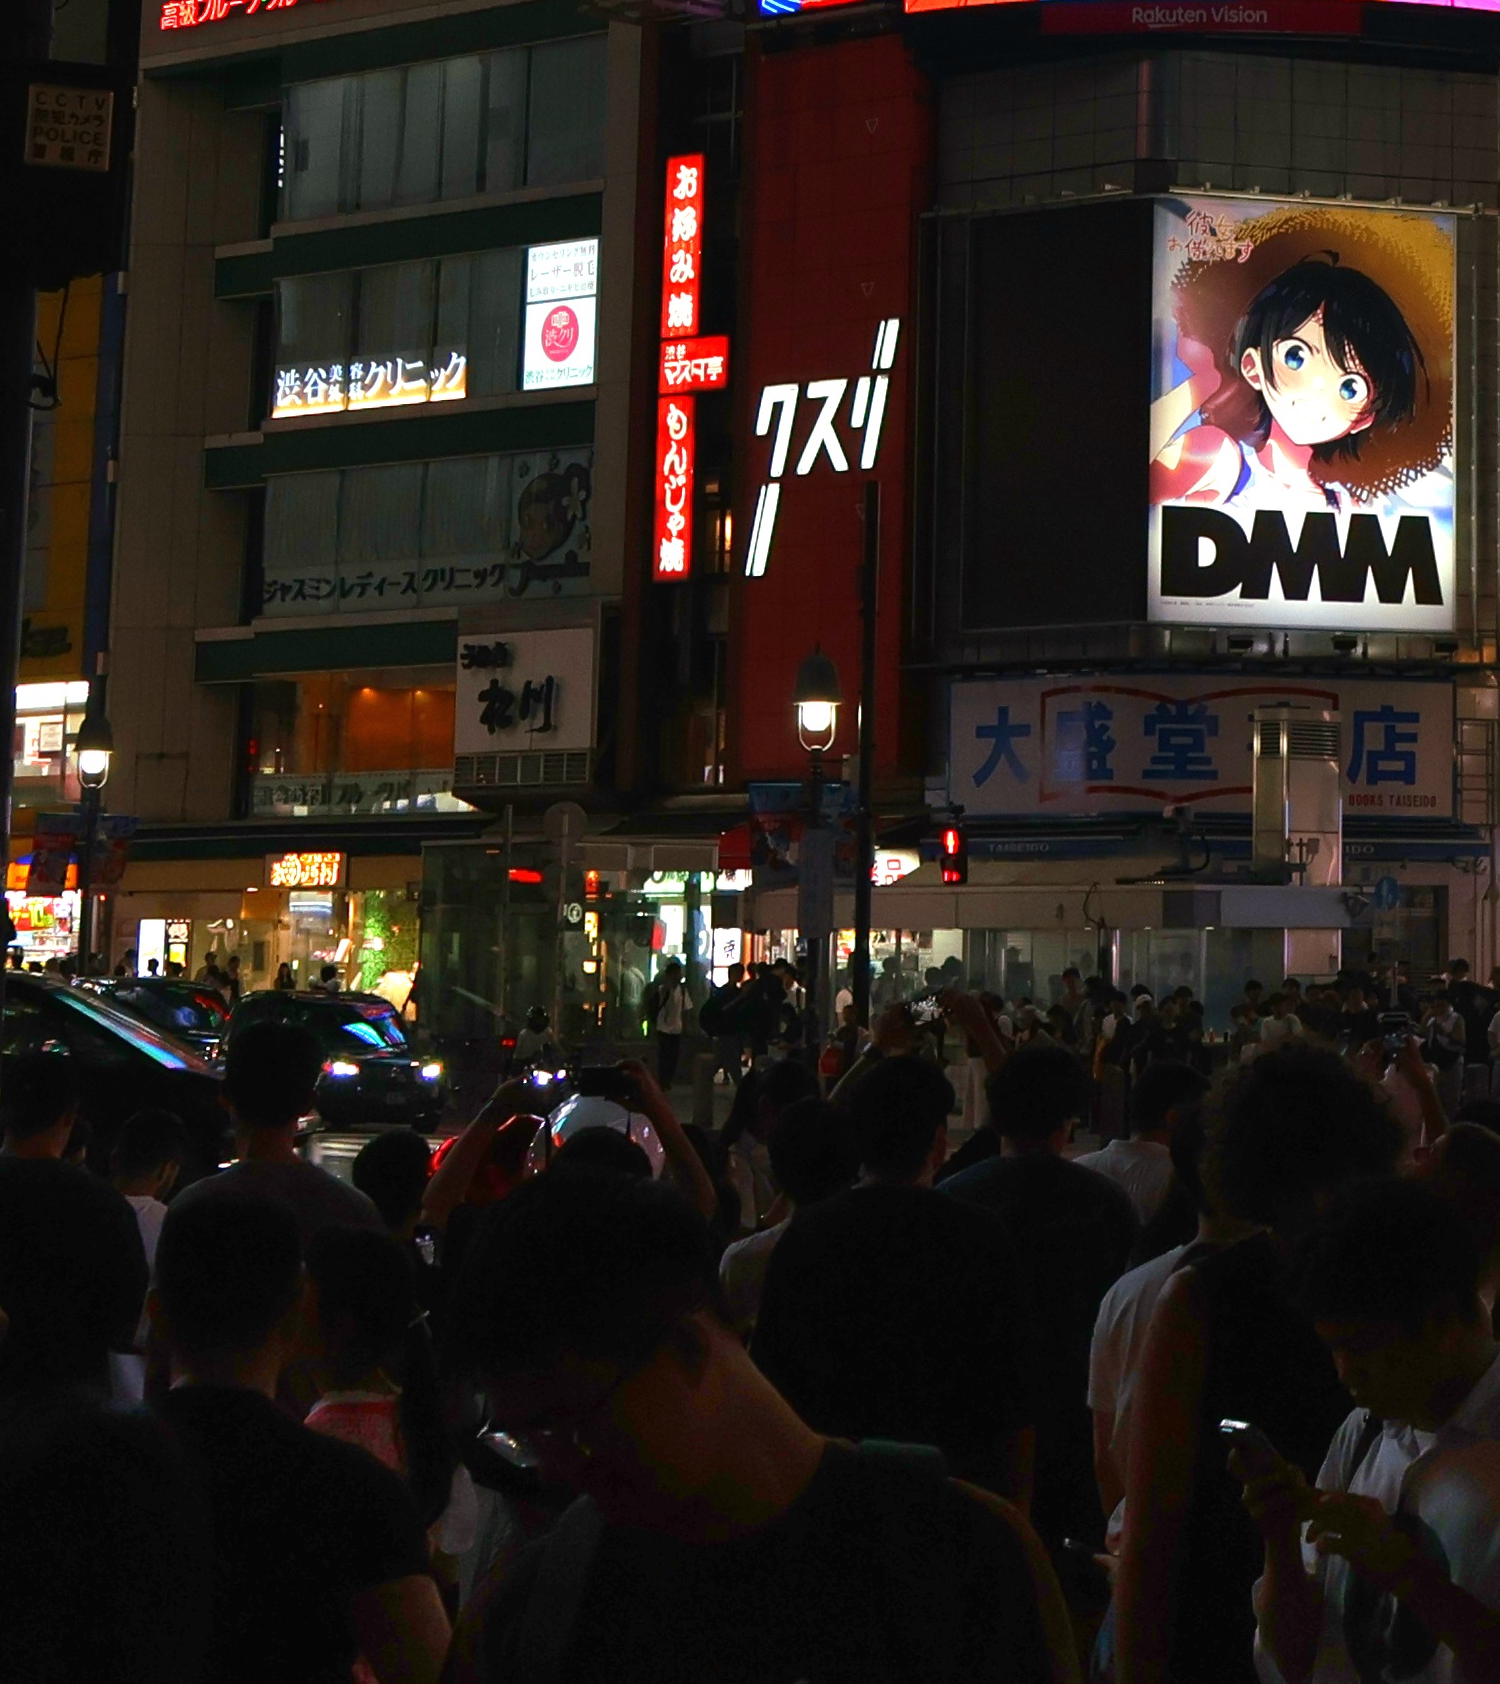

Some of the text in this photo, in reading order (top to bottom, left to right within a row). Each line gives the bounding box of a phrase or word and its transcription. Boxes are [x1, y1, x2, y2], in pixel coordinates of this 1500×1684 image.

[1132, 5, 1269, 26] Rakuten Vision
[35, 91, 106, 111] CCTV
[33, 125, 106, 147] POLICE
[530, 260, 595, 282] レーザー脱毛
[1161, 505, 1445, 606] DMM
[972, 700, 1420, 788] 大盛堂店
[1349, 793, 1437, 809] BOOKS TAISEIDO
